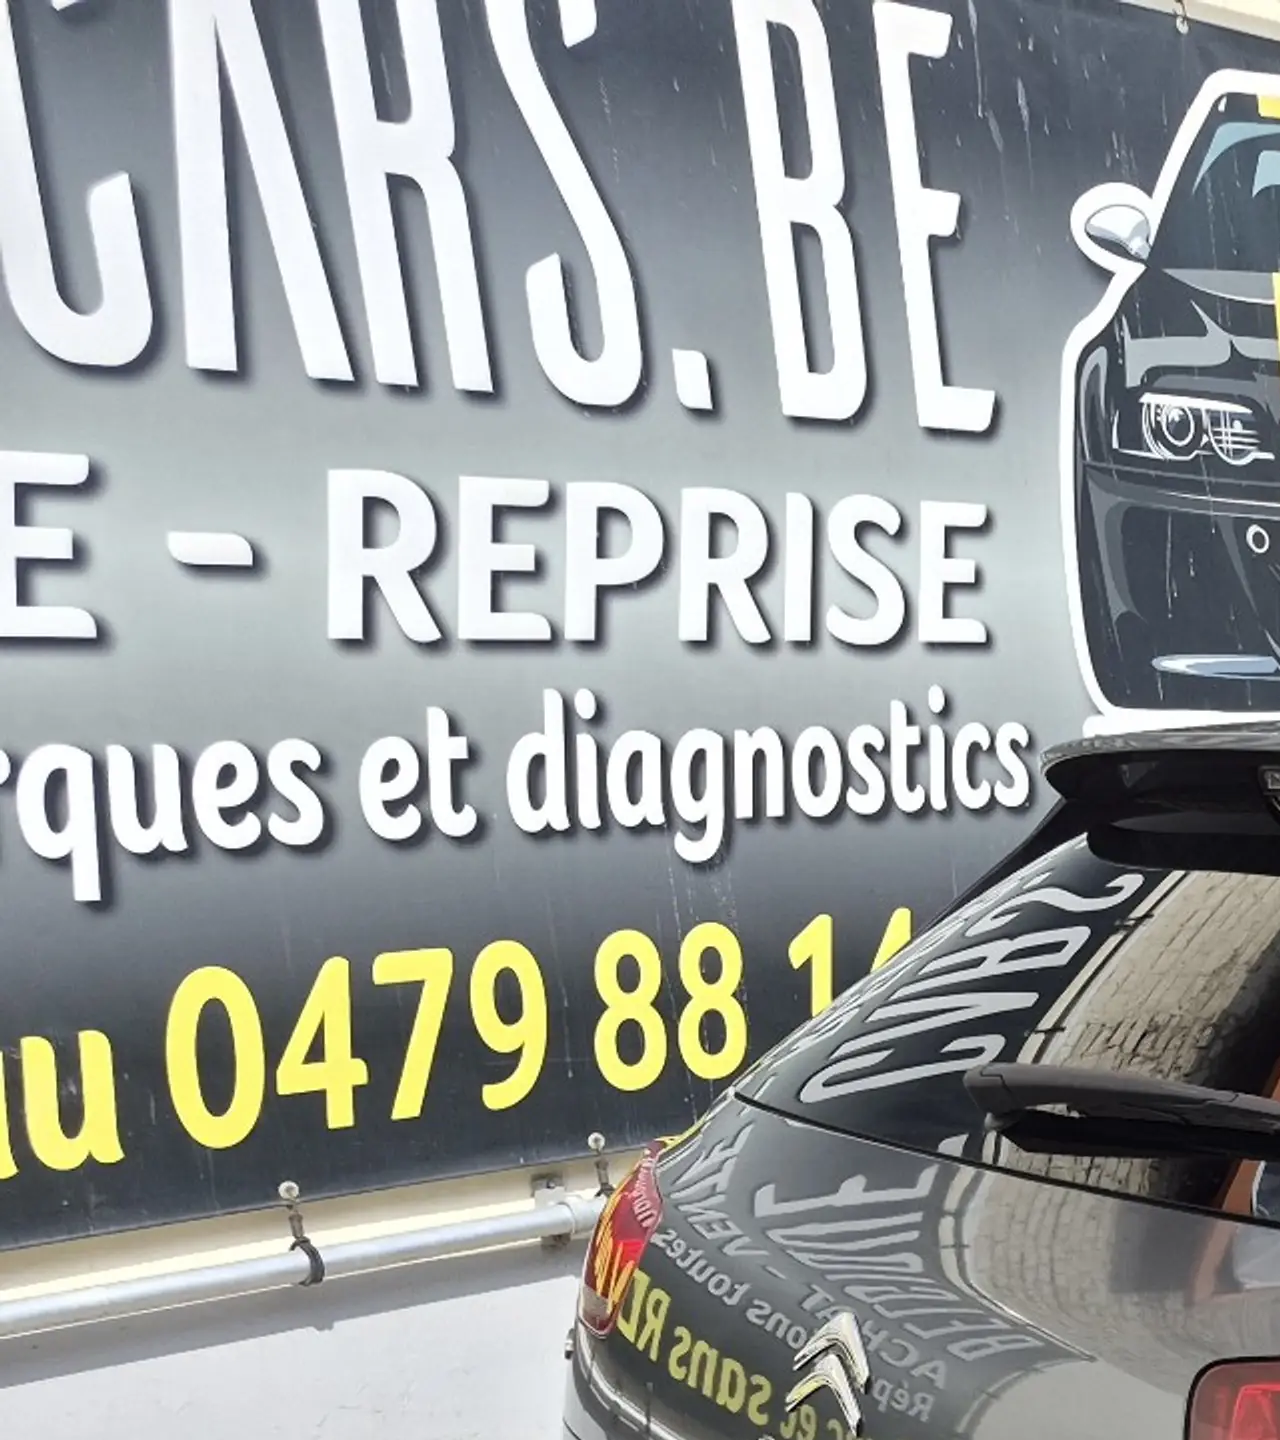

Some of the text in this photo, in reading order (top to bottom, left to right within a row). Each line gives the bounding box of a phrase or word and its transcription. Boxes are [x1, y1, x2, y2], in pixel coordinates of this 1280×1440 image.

[327, 468, 988, 648] REPRISE
[359, 706, 477, 841] et
[506, 684, 1030, 863] diagnostics
[0, 906, 913, 1180] u 0479 88 1
